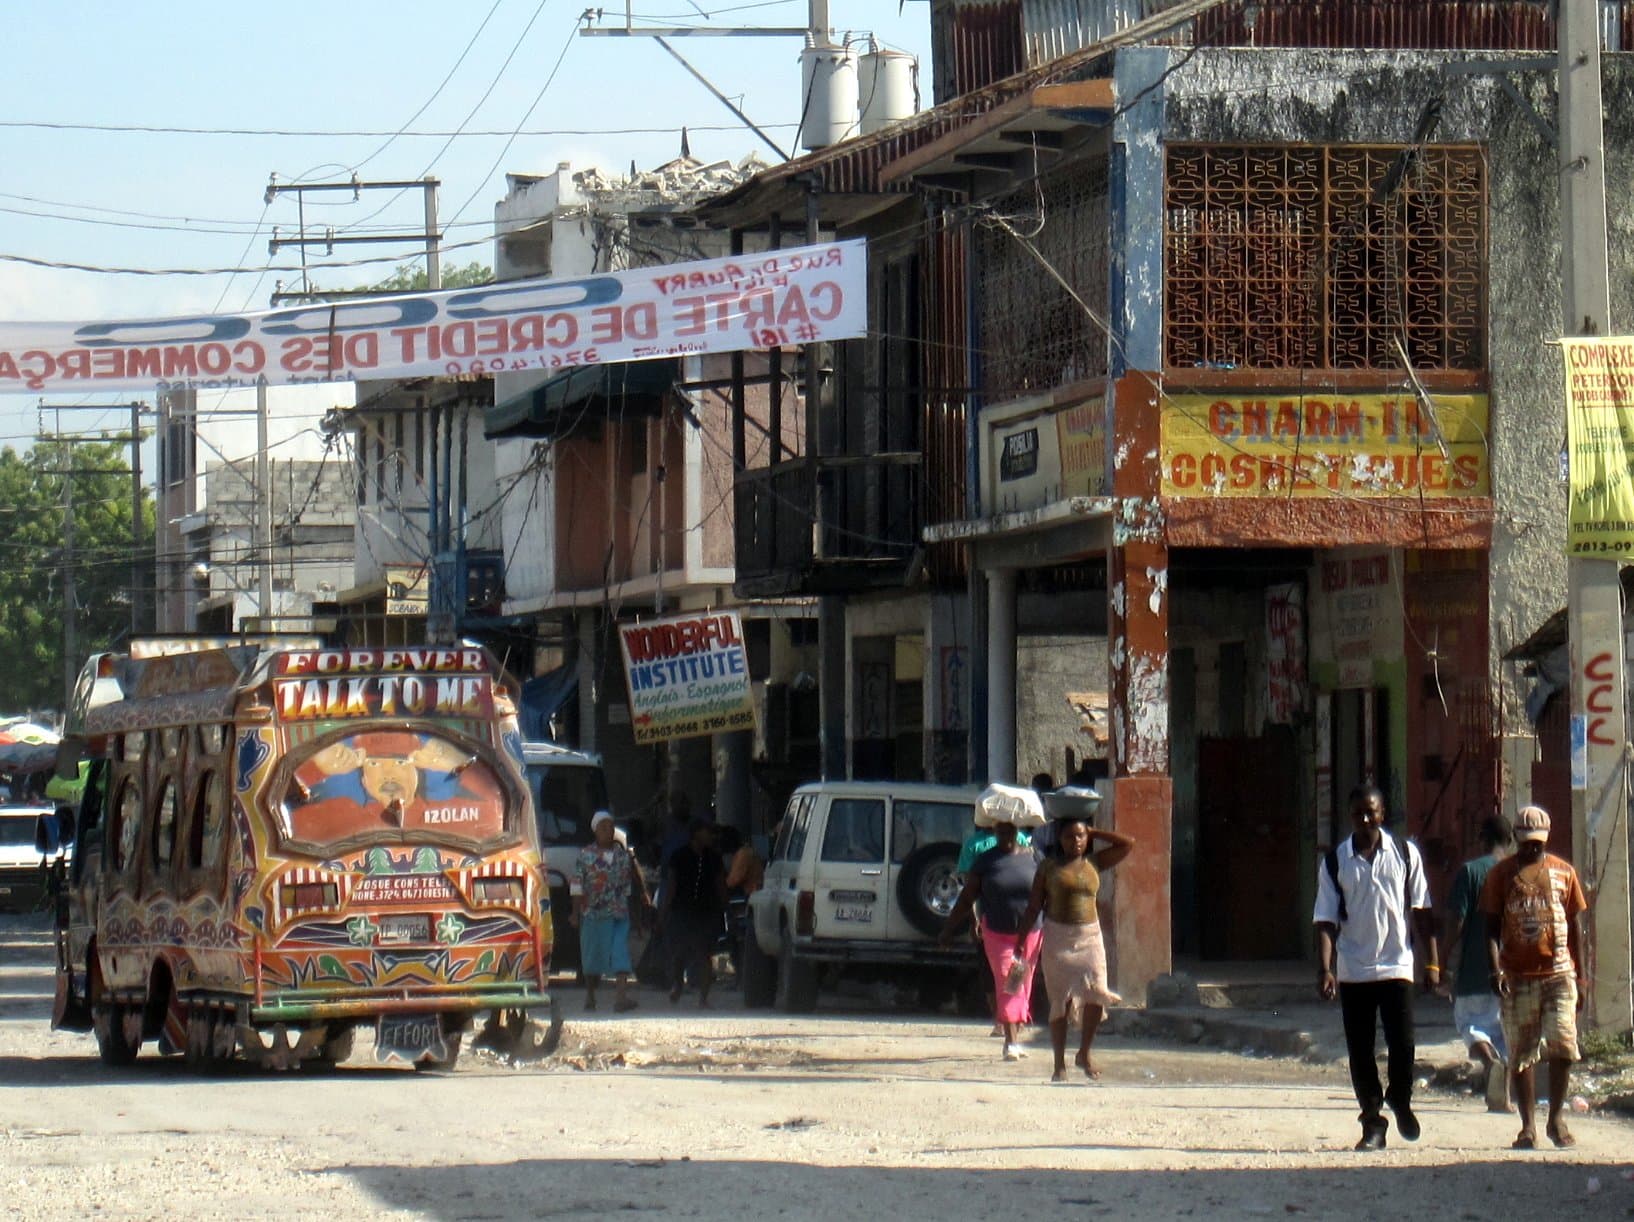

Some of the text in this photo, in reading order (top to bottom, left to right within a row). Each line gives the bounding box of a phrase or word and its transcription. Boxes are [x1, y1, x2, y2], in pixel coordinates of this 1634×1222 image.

[1569, 344, 1634, 368] COMPLEXE
[1170, 451, 1480, 491] COSMETQUES
[622, 615, 741, 664] WONDERFUL
[285, 650, 483, 673] FOREVER
[629, 650, 745, 691] INSTITUTE
[277, 676, 484, 719] TALK TO ME
[686, 676, 748, 702] Espagnol
[424, 807, 480, 824] IZOLAN
[382, 1022, 441, 1047] EFFORT
